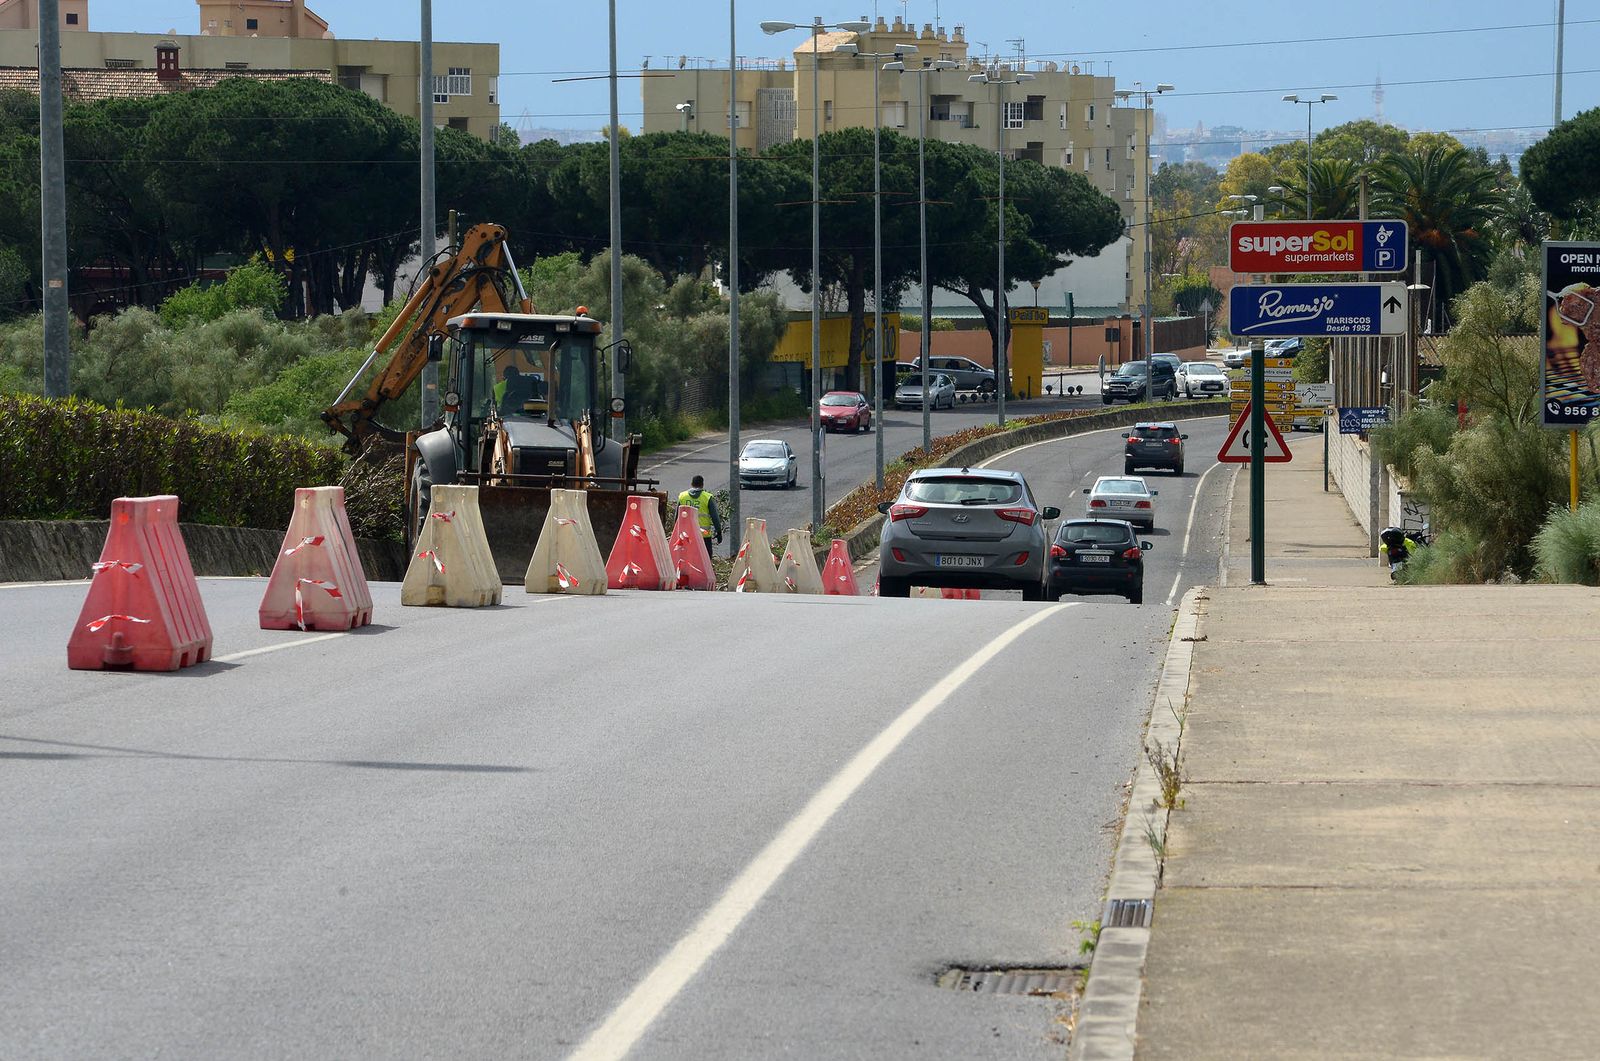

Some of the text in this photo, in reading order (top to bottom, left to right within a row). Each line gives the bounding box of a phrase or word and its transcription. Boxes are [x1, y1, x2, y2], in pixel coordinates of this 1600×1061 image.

[1238, 229, 1354, 256] superSol
[1284, 252, 1355, 264] supermarkets
[1378, 251, 1391, 266] P
[1560, 253, 1593, 264] OPEN
[1571, 265, 1600, 273] morni
[1326, 316, 1371, 324] MARISCOS
[1326, 324, 1371, 332] Desde 1952
[1564, 406, 1587, 416] 956
[1340, 417, 1361, 428] tecs
[941, 557, 983, 566] 8010 JNX
